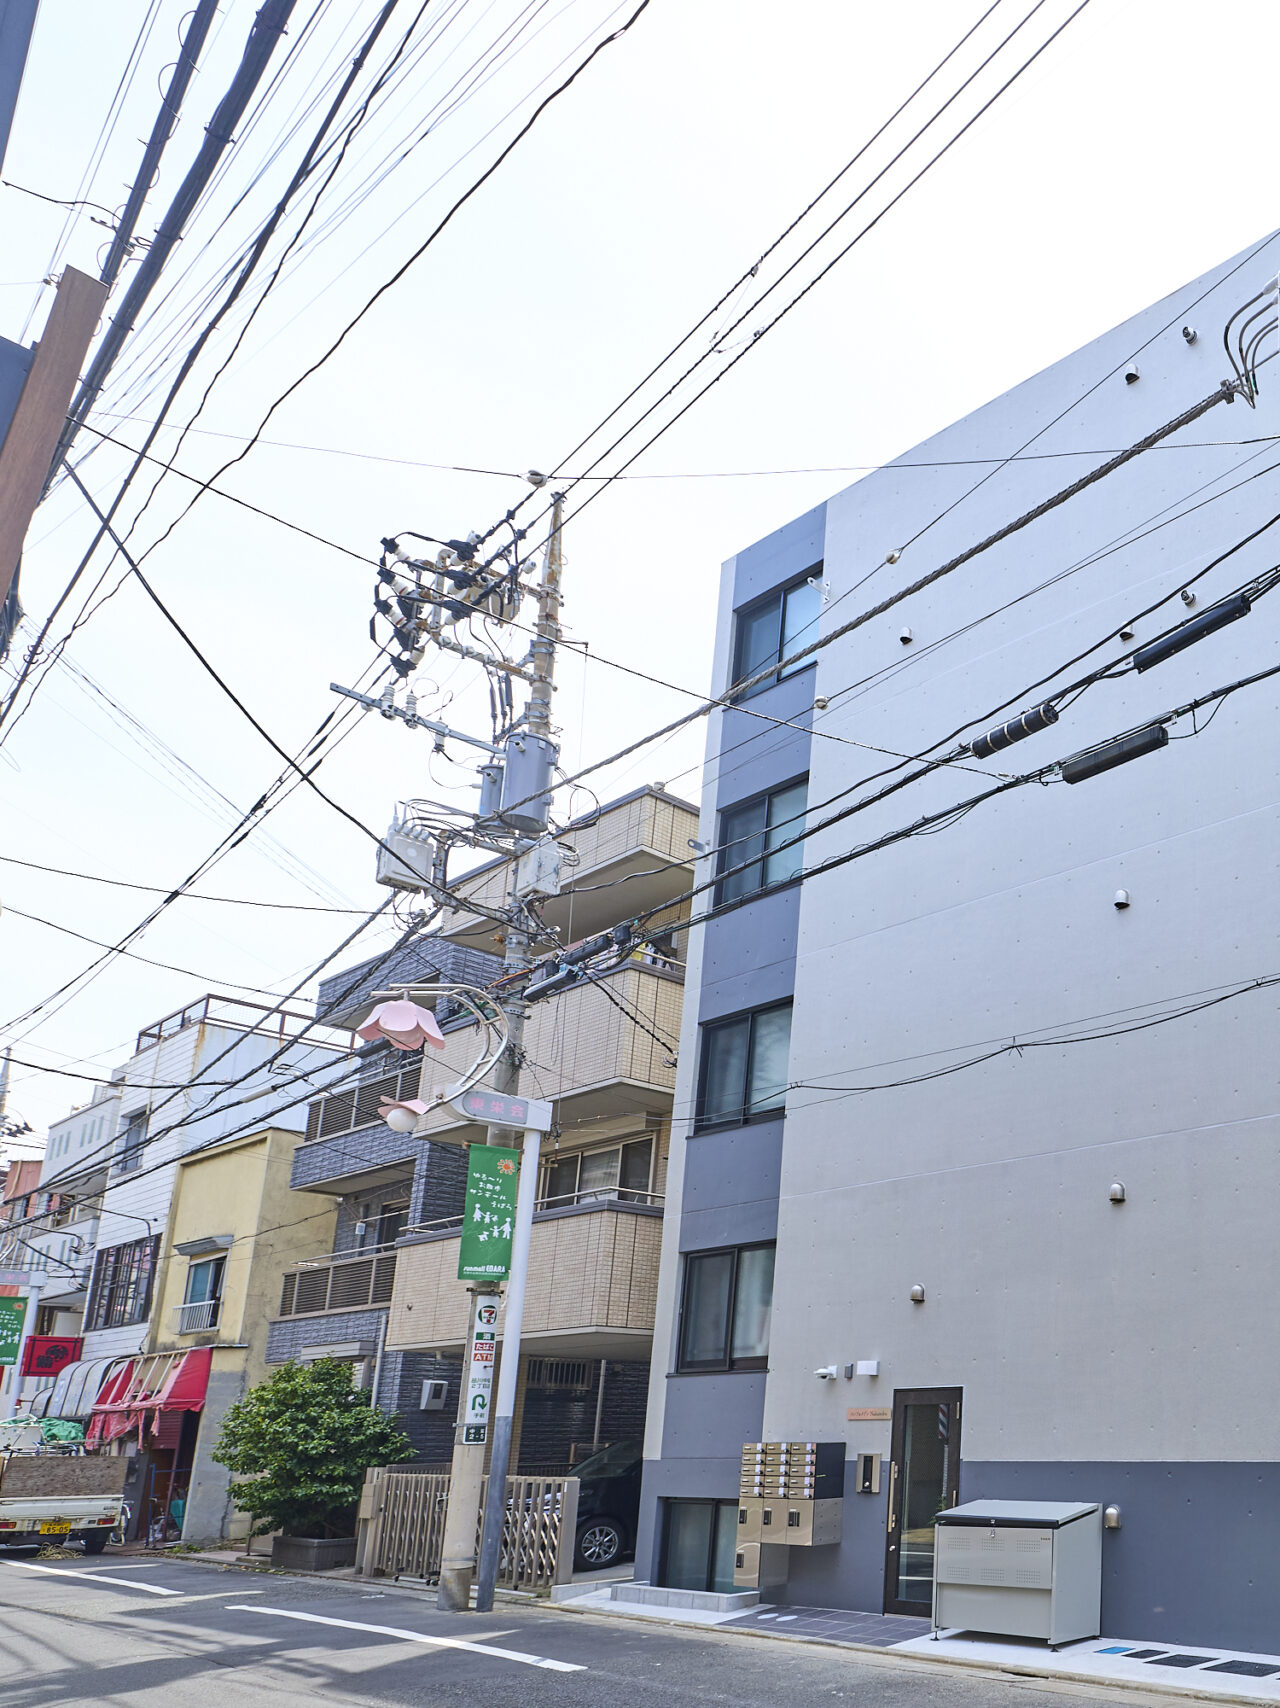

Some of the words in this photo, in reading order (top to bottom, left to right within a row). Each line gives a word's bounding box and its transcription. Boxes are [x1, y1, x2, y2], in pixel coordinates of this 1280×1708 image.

[470, 1097, 523, 1118] 東栄会
[469, 1188, 506, 1201] サンモール
[491, 1200, 512, 1211] えばら
[475, 1353, 493, 1361] ATM
